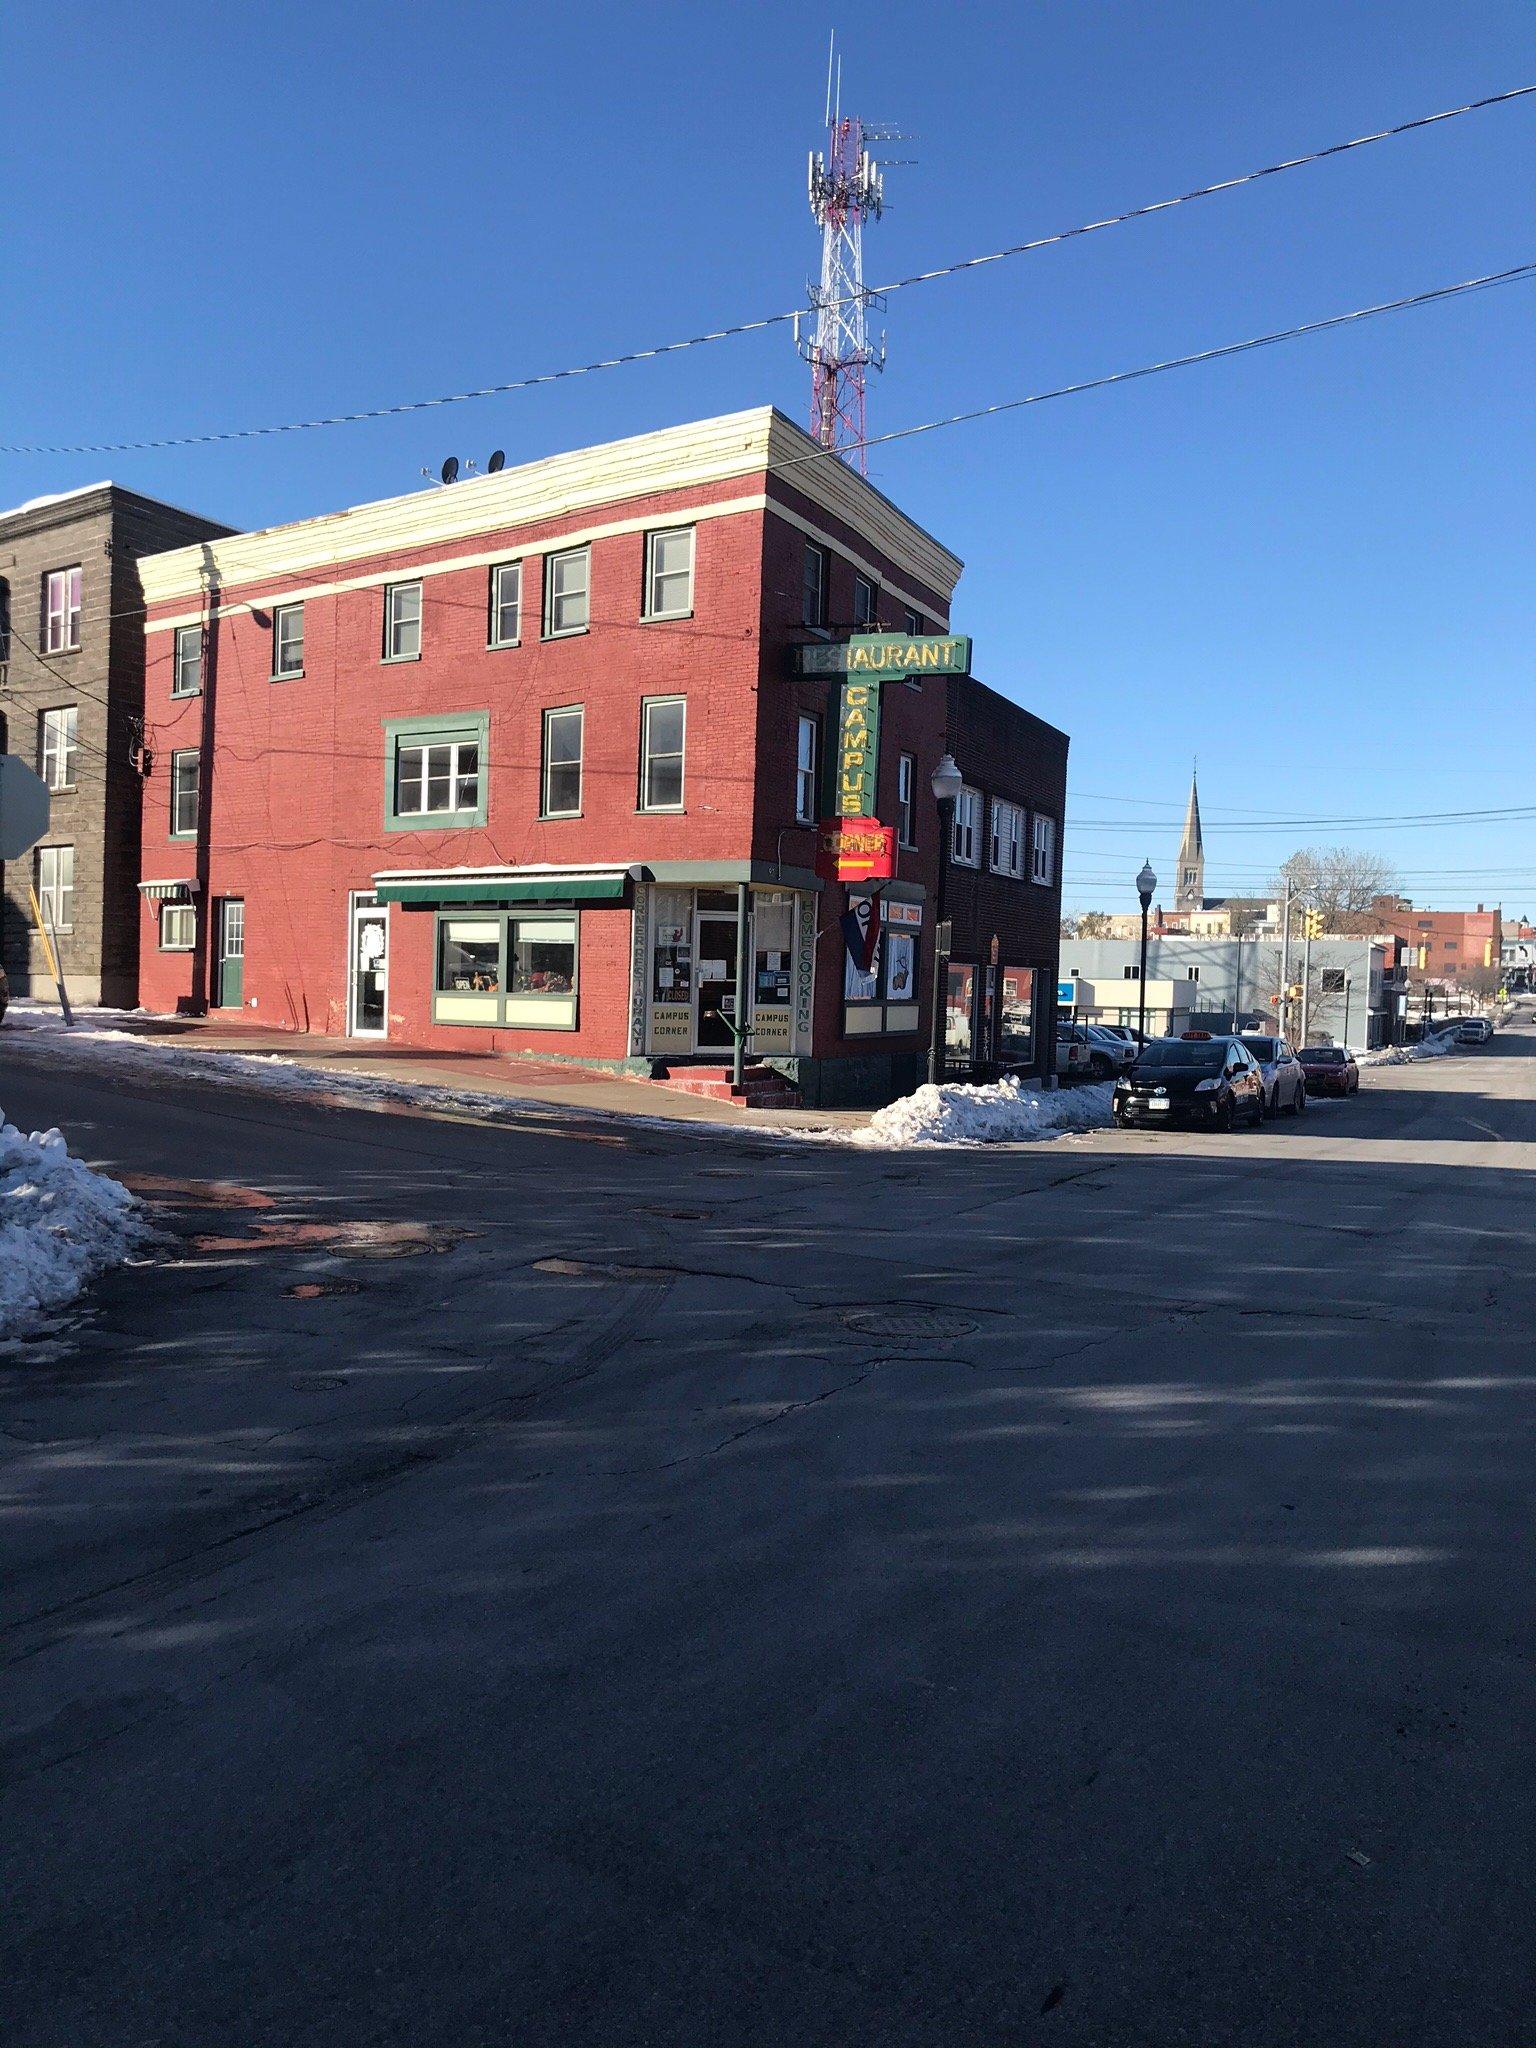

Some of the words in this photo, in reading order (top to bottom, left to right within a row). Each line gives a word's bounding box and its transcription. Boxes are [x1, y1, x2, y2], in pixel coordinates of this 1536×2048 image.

[842, 686, 868, 813] CAMPUS
[654, 1012, 689, 1020] CAMPUS
[755, 1013, 789, 1022] CAMPUS
[654, 1027, 688, 1035] CORNER
[755, 1028, 788, 1036] CORNER
